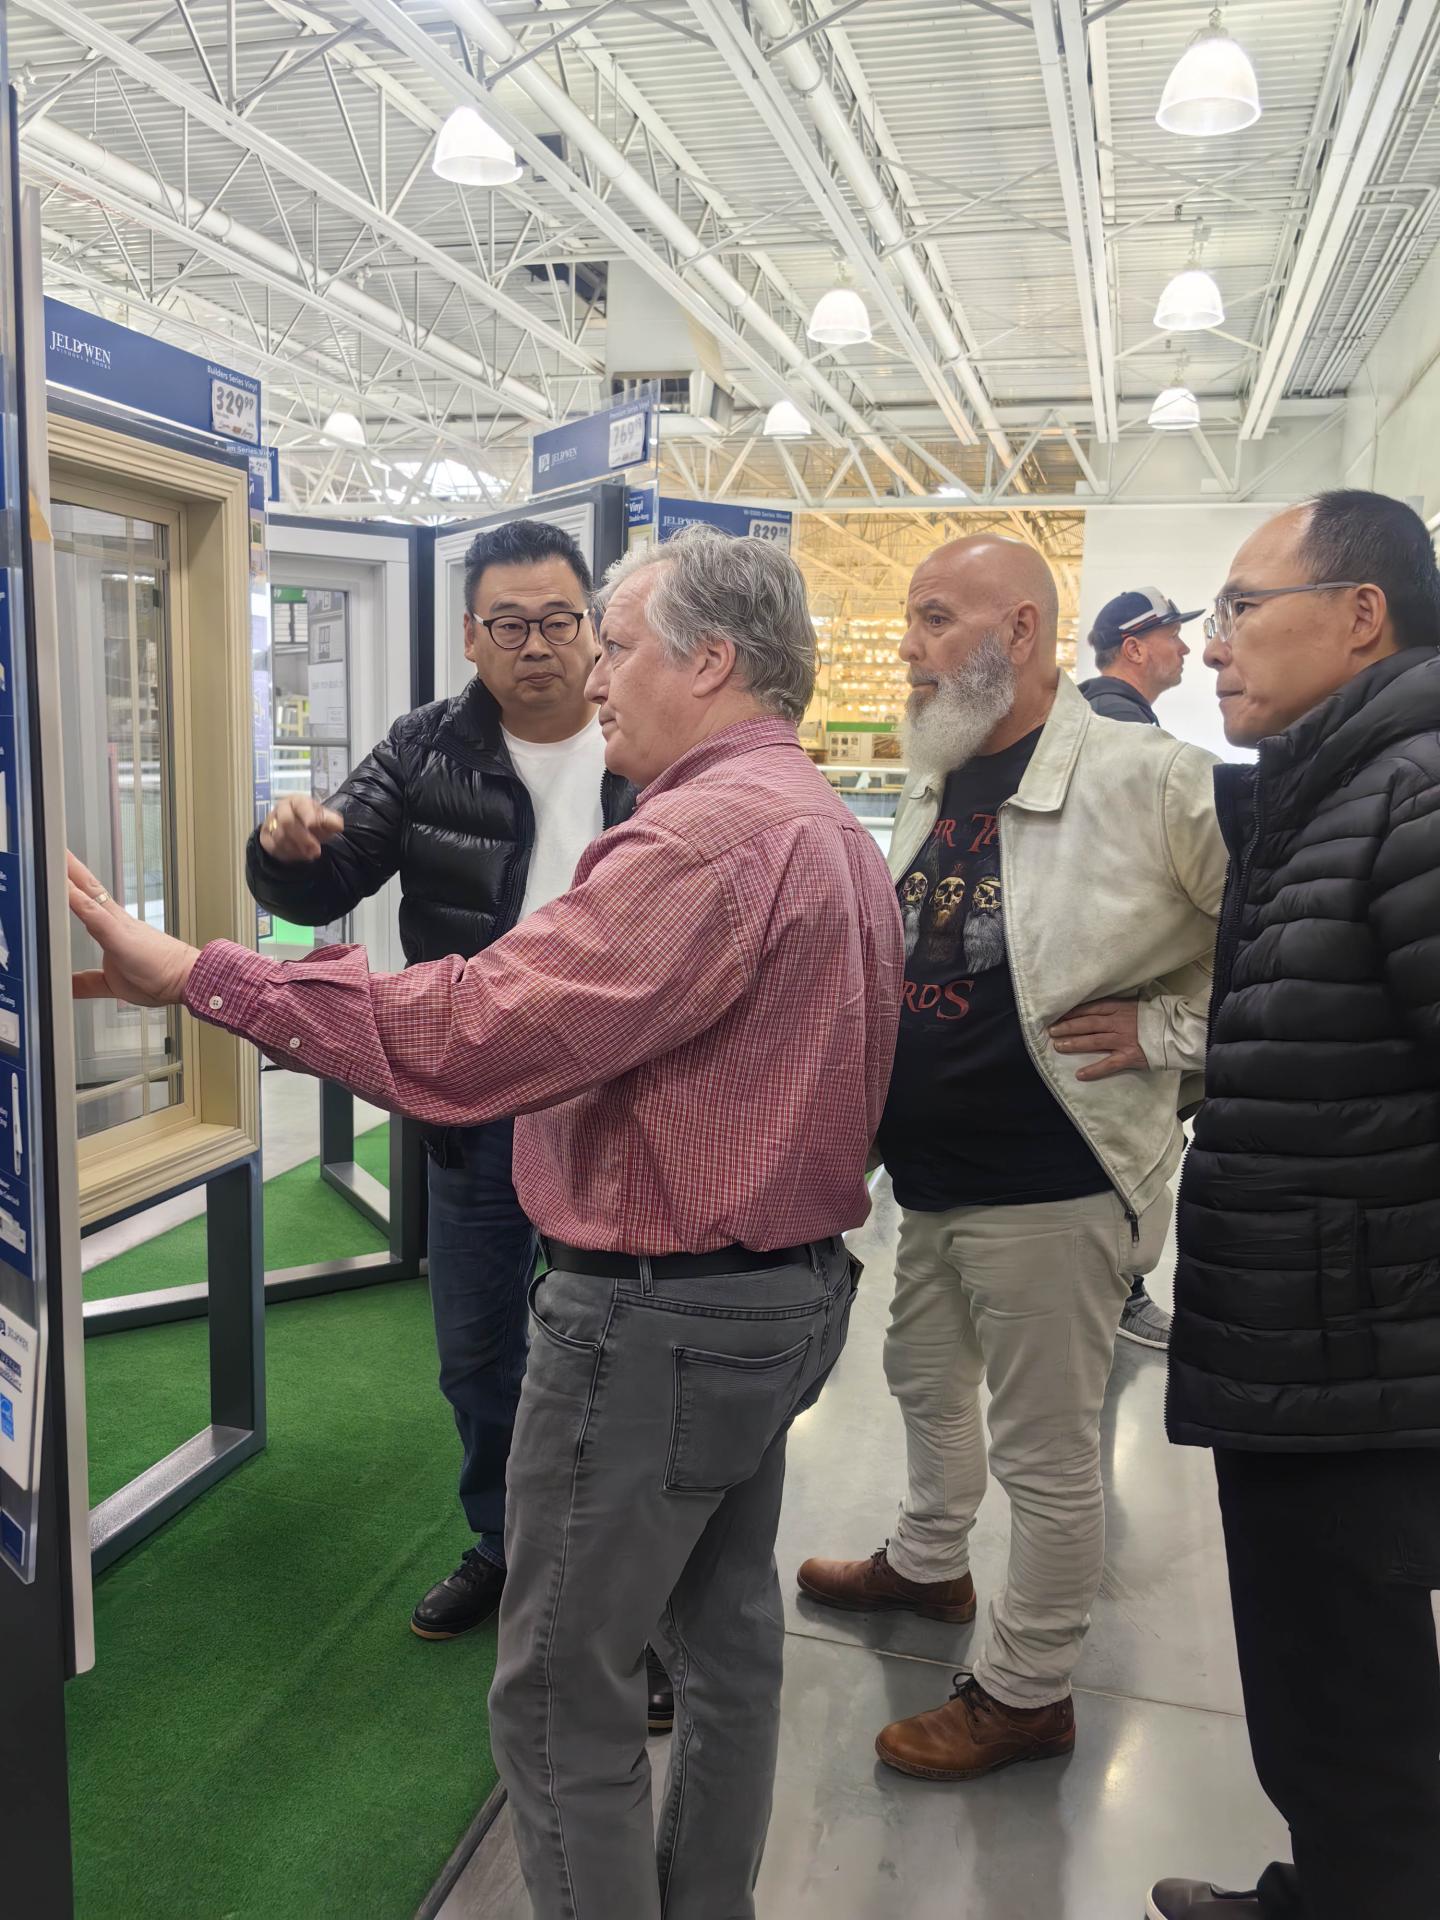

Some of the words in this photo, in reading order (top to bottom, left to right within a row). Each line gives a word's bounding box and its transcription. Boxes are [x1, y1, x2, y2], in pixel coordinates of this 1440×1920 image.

[207, 364, 229, 380] Builders
[229, 373, 244, 387] Series
[244, 379, 258, 393] Vinyl
[630, 499, 644, 514] Vinyl
